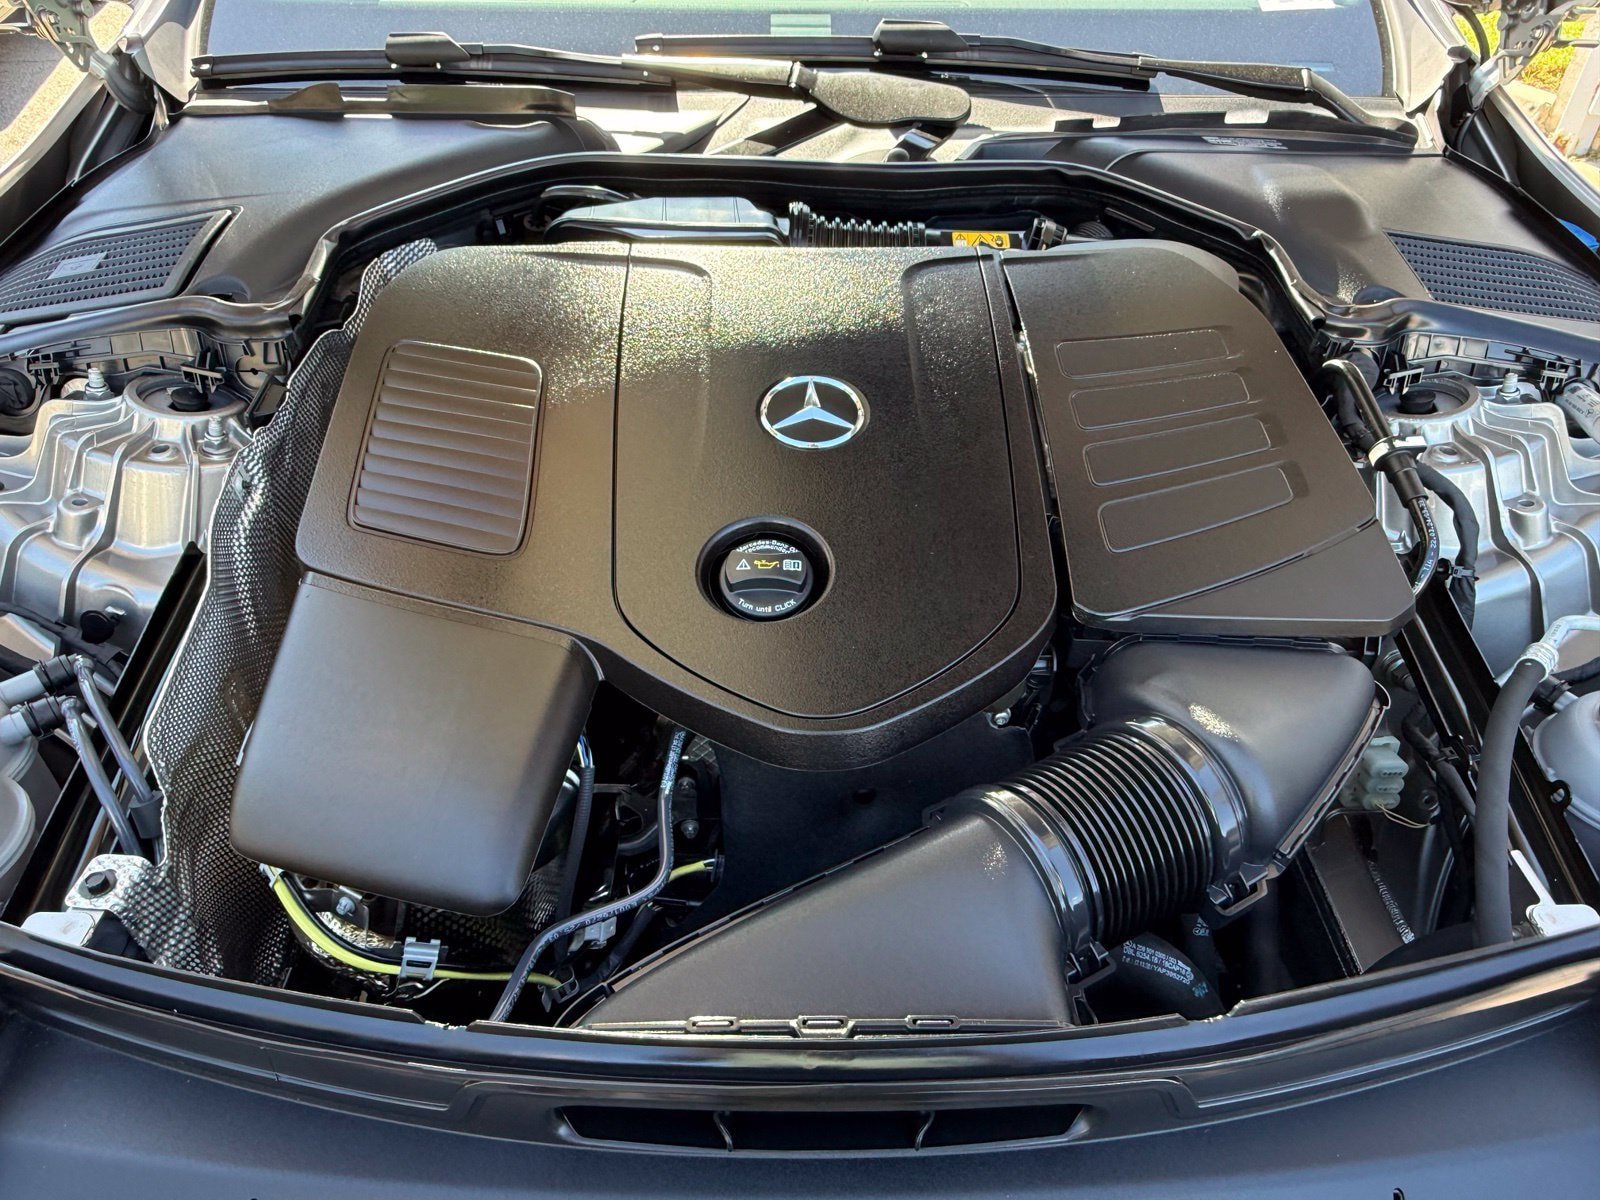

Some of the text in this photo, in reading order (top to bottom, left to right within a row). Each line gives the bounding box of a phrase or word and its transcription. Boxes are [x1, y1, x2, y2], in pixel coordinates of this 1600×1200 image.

[738, 598, 797, 613] Turn until CLICK
